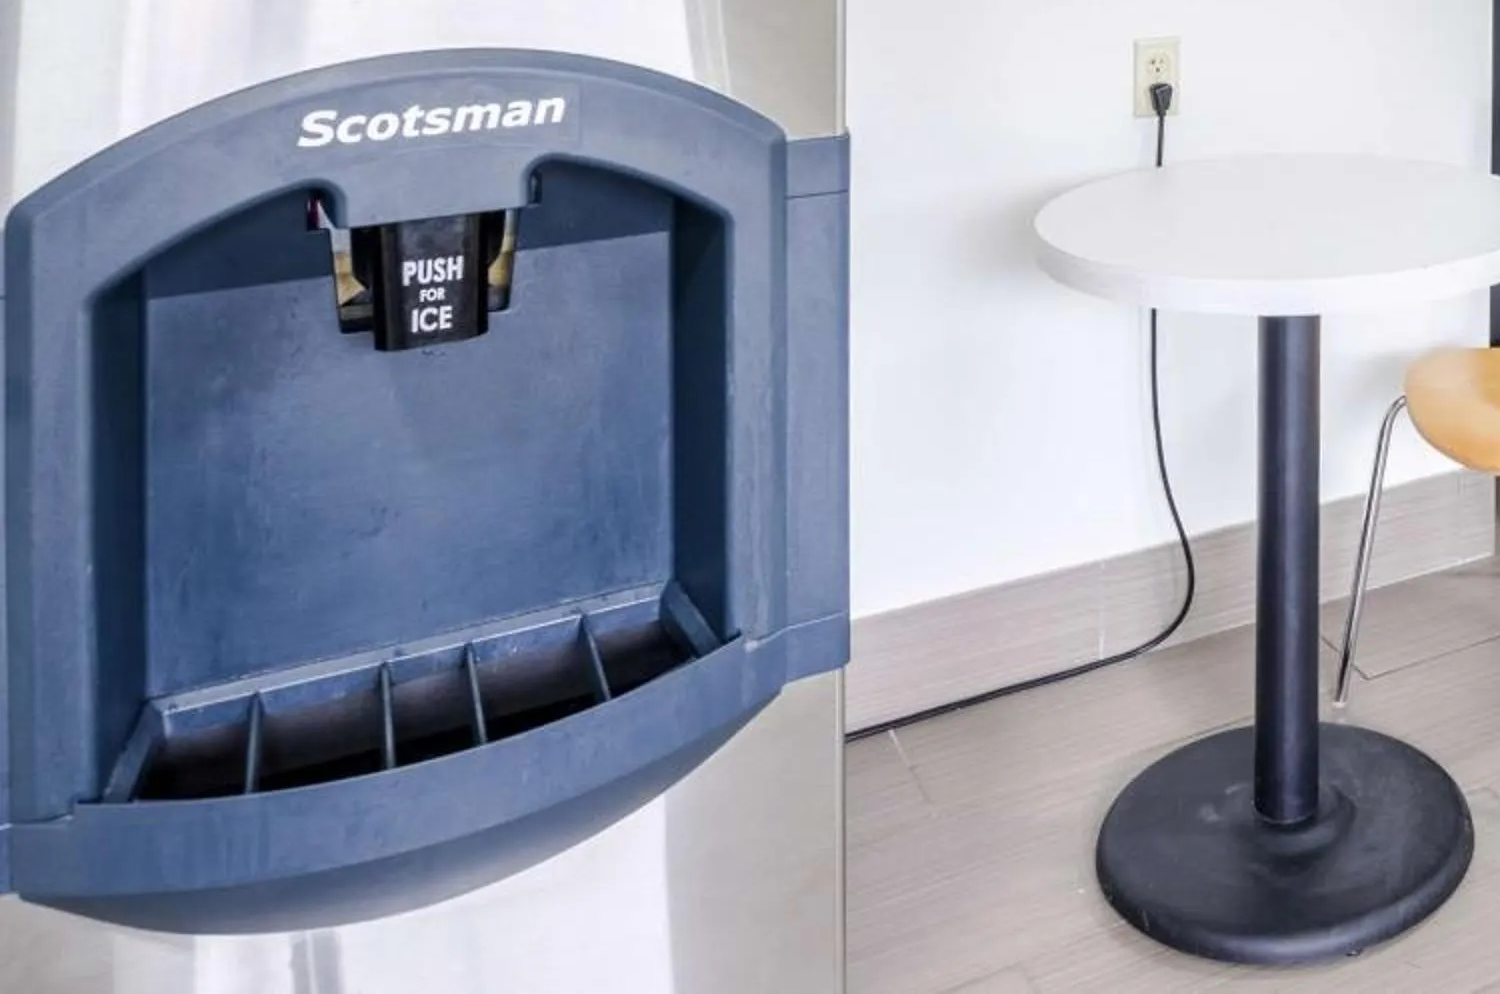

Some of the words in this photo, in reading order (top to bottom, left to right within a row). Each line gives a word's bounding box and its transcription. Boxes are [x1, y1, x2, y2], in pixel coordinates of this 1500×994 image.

[296, 97, 566, 147] Scotsman
[402, 255, 464, 287] PUSH
[419, 287, 446, 302] FOR
[411, 305, 453, 334] ICE
